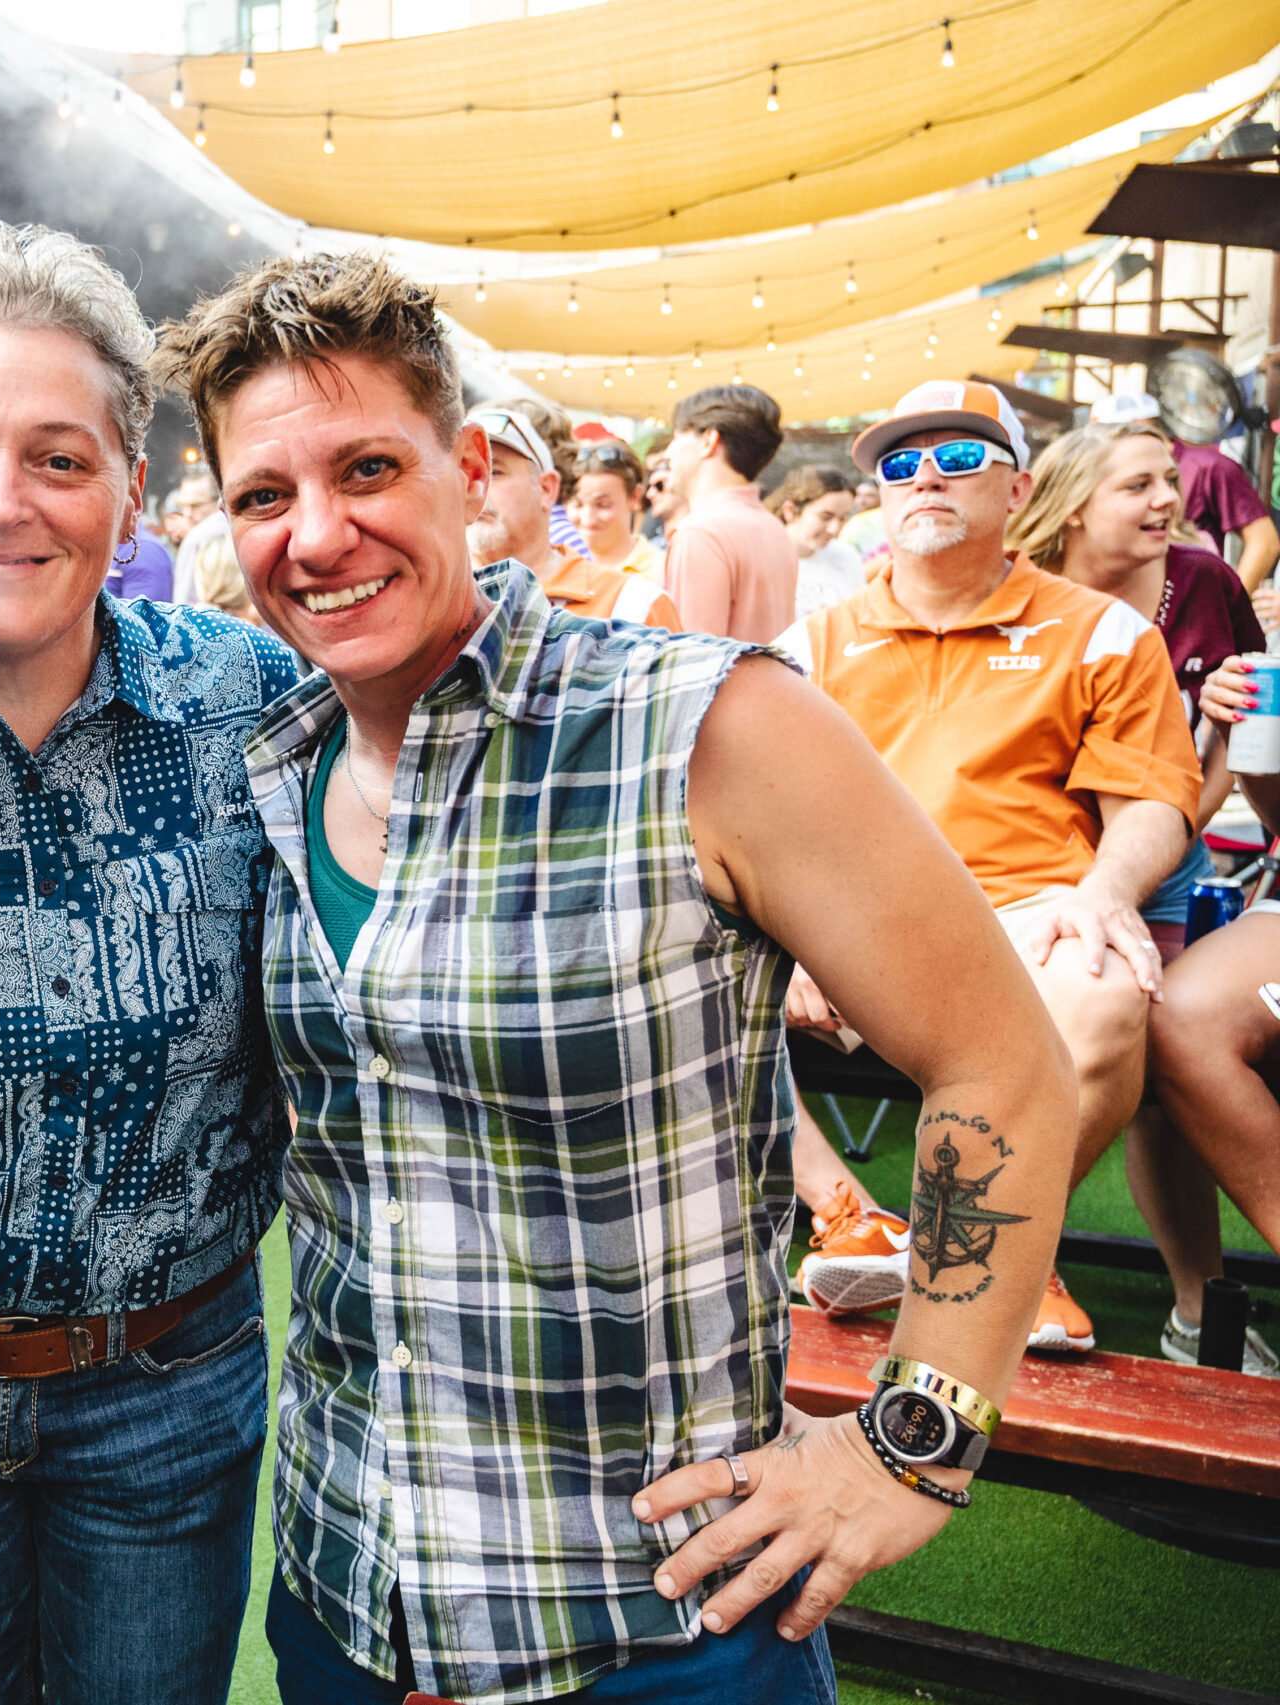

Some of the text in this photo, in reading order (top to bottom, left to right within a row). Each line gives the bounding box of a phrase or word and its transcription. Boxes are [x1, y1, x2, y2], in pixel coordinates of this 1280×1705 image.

[987, 655, 1040, 670] TEXAS
[215, 800, 259, 819] ARIAT
[914, 1373, 958, 1404] VIP
[901, 1405, 927, 1443] 06:02
